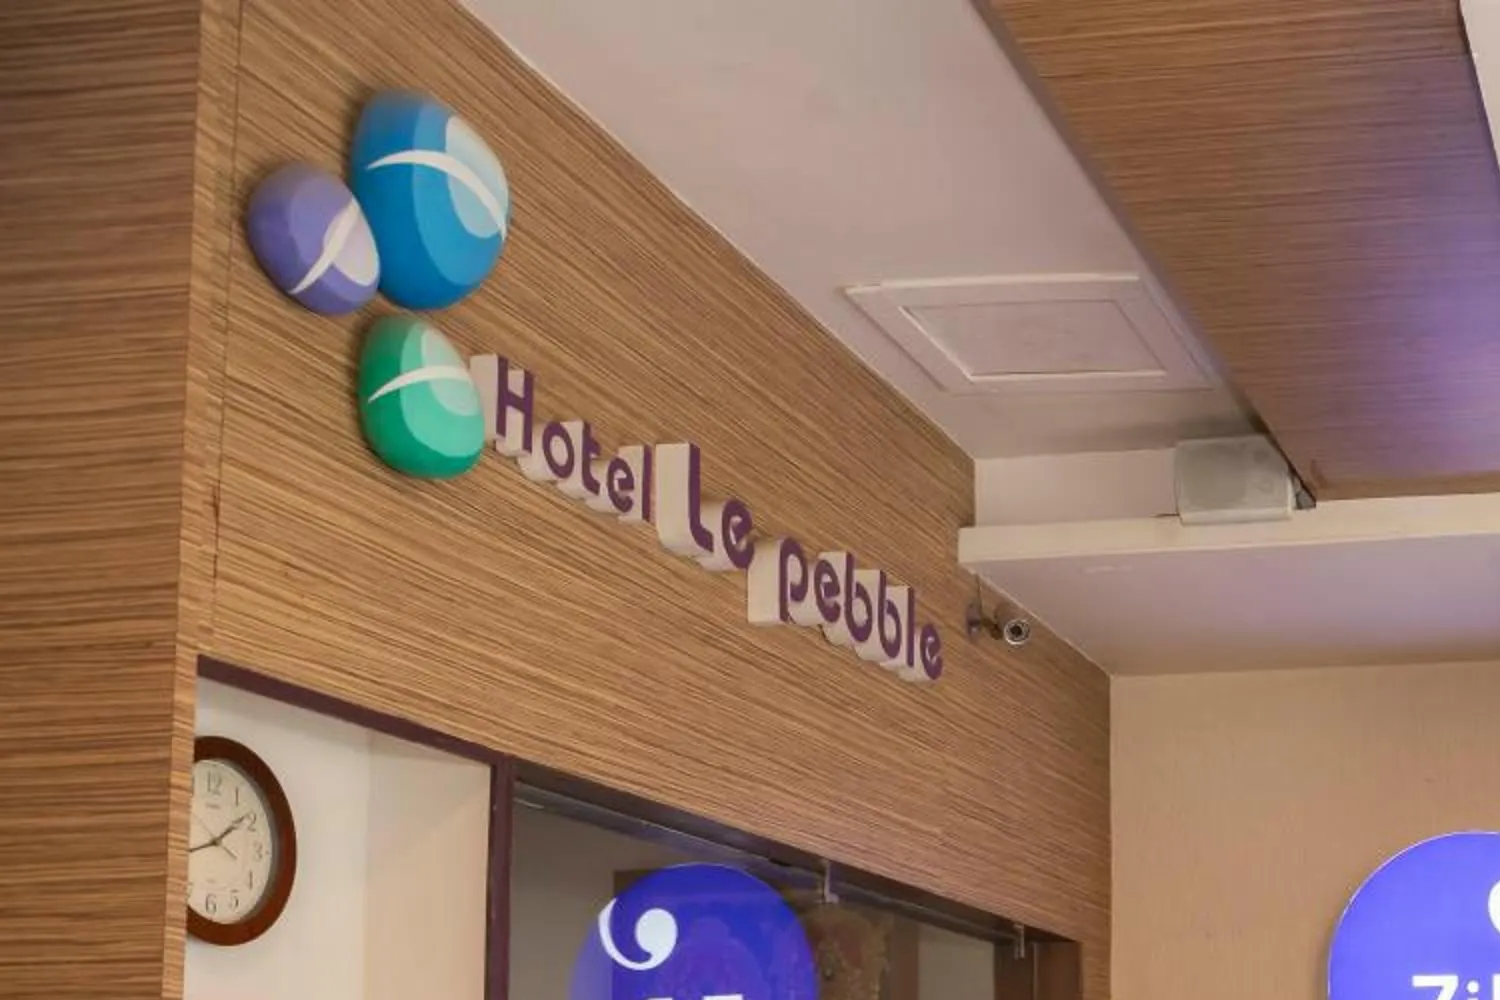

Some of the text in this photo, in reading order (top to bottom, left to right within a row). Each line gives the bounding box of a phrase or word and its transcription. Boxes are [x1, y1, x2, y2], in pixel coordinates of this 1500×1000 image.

[495, 354, 944, 681] Hotel Le pebble
